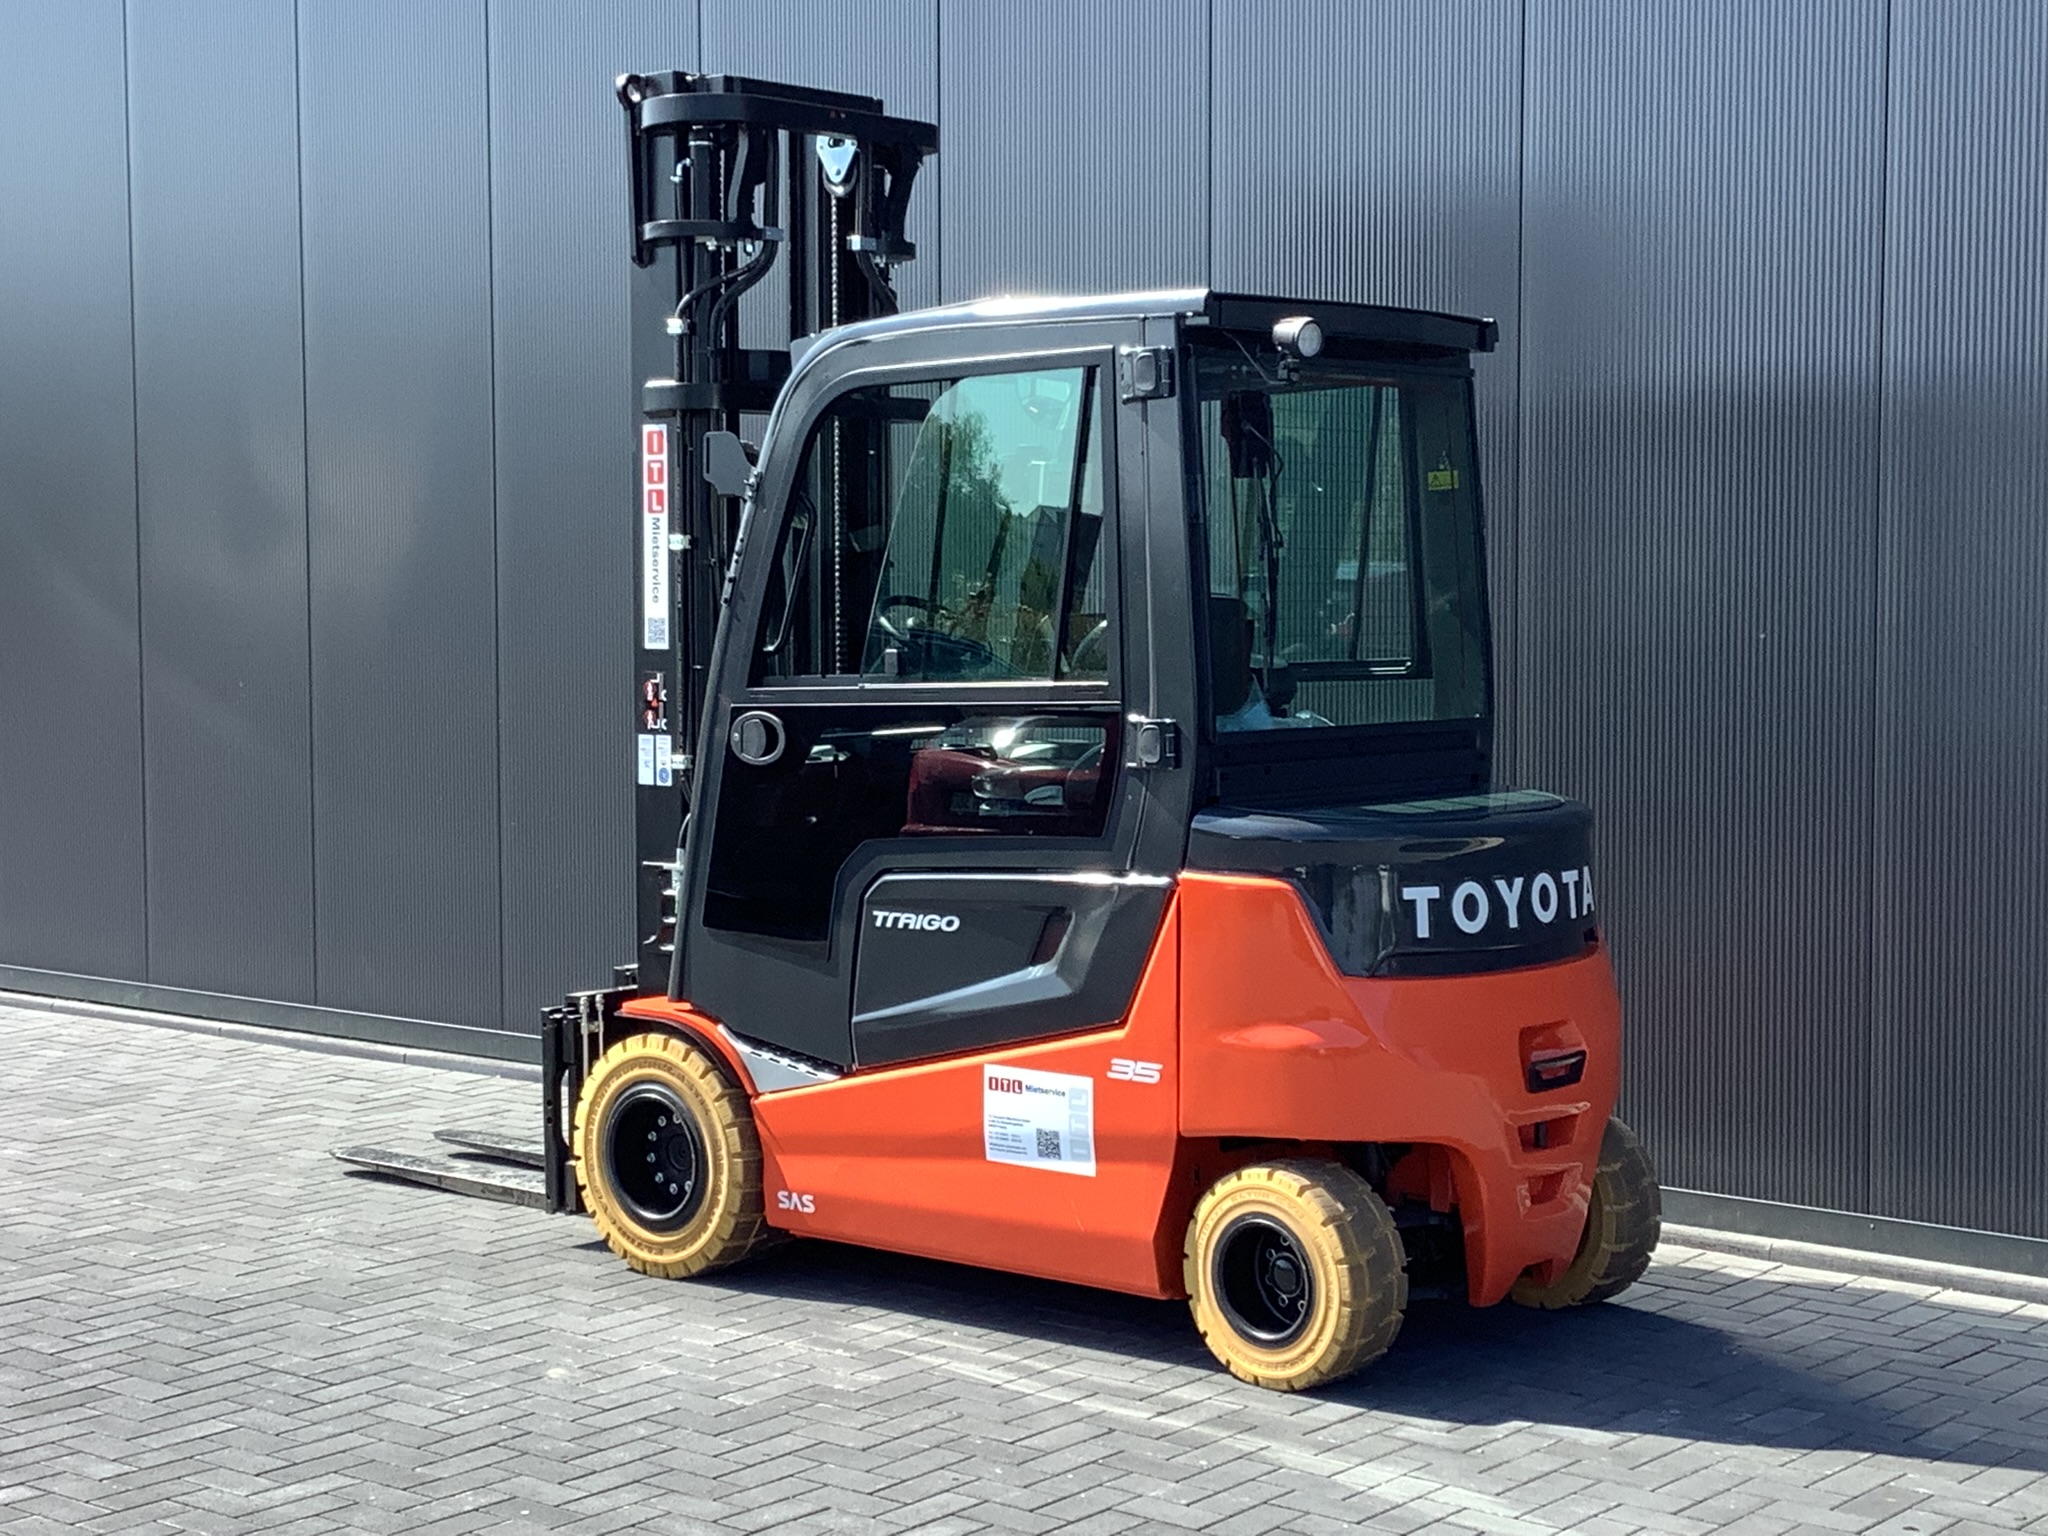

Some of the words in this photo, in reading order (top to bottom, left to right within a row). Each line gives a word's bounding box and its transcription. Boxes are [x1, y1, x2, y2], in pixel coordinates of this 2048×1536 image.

[648, 431, 664, 513] ITL
[651, 517, 661, 603] Mietservice
[1402, 866, 1595, 939] TOYOTA
[989, 1076, 1022, 1094] ITL
[1025, 1085, 1066, 1097] Mietservice
[1106, 1058, 1163, 1084] 35
[777, 1191, 815, 1213] SAS
